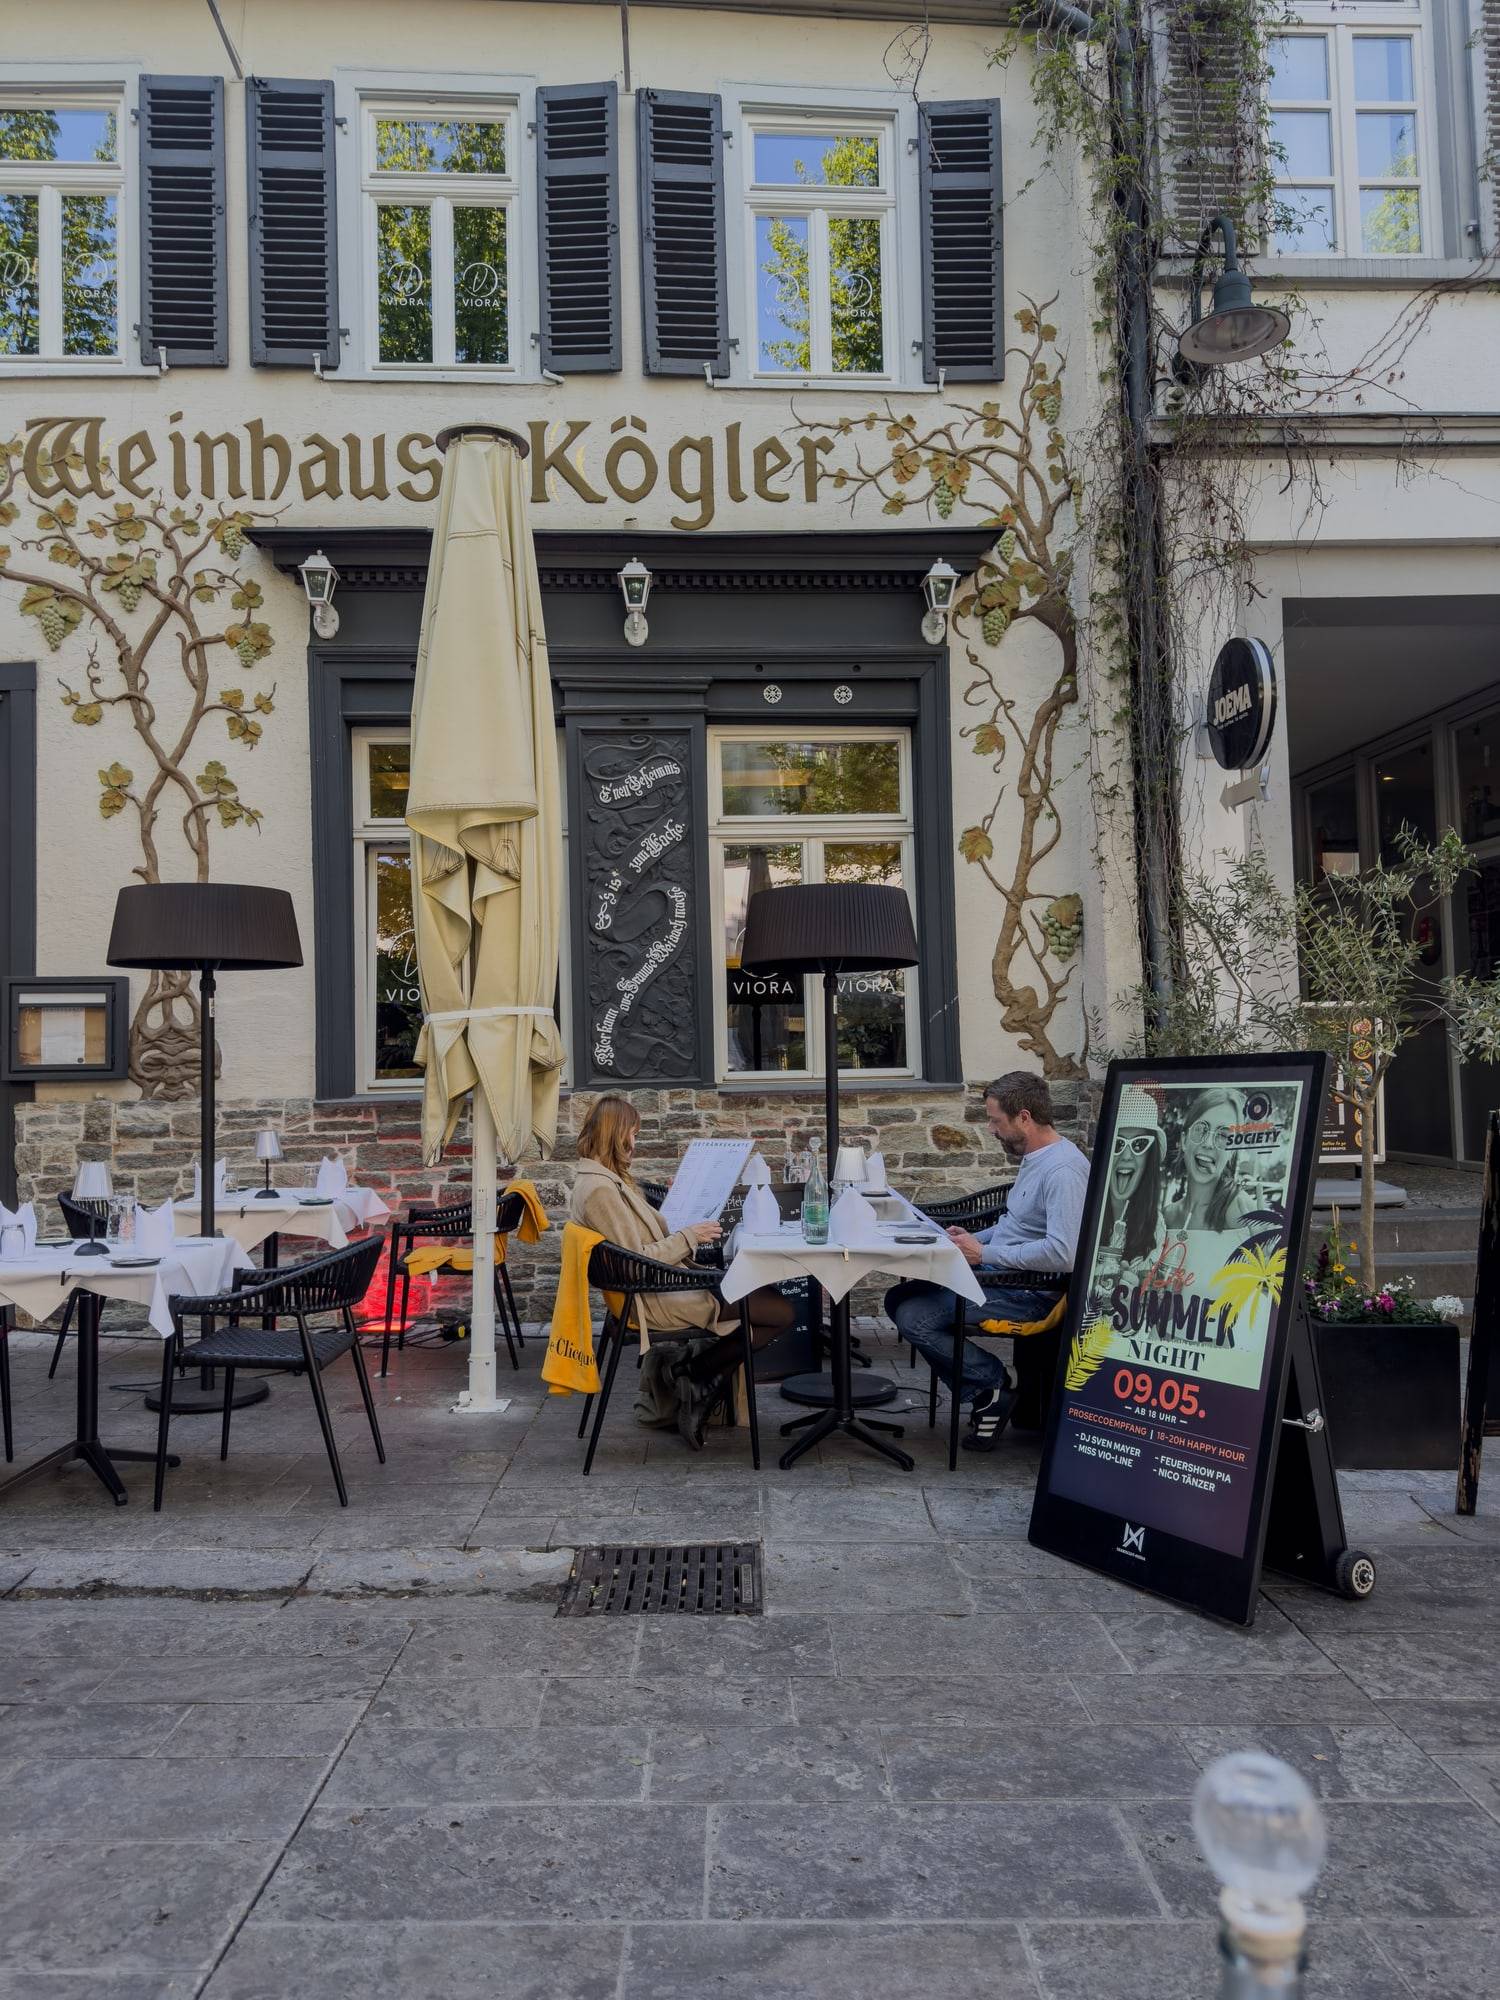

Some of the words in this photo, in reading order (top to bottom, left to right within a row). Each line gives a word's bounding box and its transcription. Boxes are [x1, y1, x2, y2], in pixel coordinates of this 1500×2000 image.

[0, 288, 31, 298] IORA
[71, 289, 109, 298] VIORA
[386, 297, 425, 306] VIORA
[462, 298, 500, 307] VIORA
[836, 308, 875, 318] VIORA
[23, 411, 444, 502] Weinhaus
[526, 414, 835, 531] Kögler
[733, 980, 794, 995] VIORA
[837, 979, 897, 993] VIORA
[386, 987, 420, 1002] VIO
[1225, 1130, 1281, 1146] SOCIETY
[1111, 1284, 1239, 1350] SUMMER
[1128, 1339, 1206, 1372] NIGHT
[1113, 1369, 1207, 1419] 09.05.
[1134, 1406, 1146, 1416] AB
[1148, 1409, 1157, 1418] 18
[1159, 1412, 1177, 1424] UHR
[1068, 1407, 1148, 1436] PROSECCOEMPFANG
[1156, 1431, 1186, 1447] 18-20H
[1186, 1440, 1217, 1455] HAPPY
[1218, 1448, 1246, 1463] HOUR
[1091, 1435, 1113, 1449] SVEN
[1113, 1441, 1141, 1457] MAYER
[1097, 1450, 1134, 1468] VIO-LINE
[1181, 1473, 1216, 1493] TÄNZER
[1215, 1471, 1232, 1484] PIA
